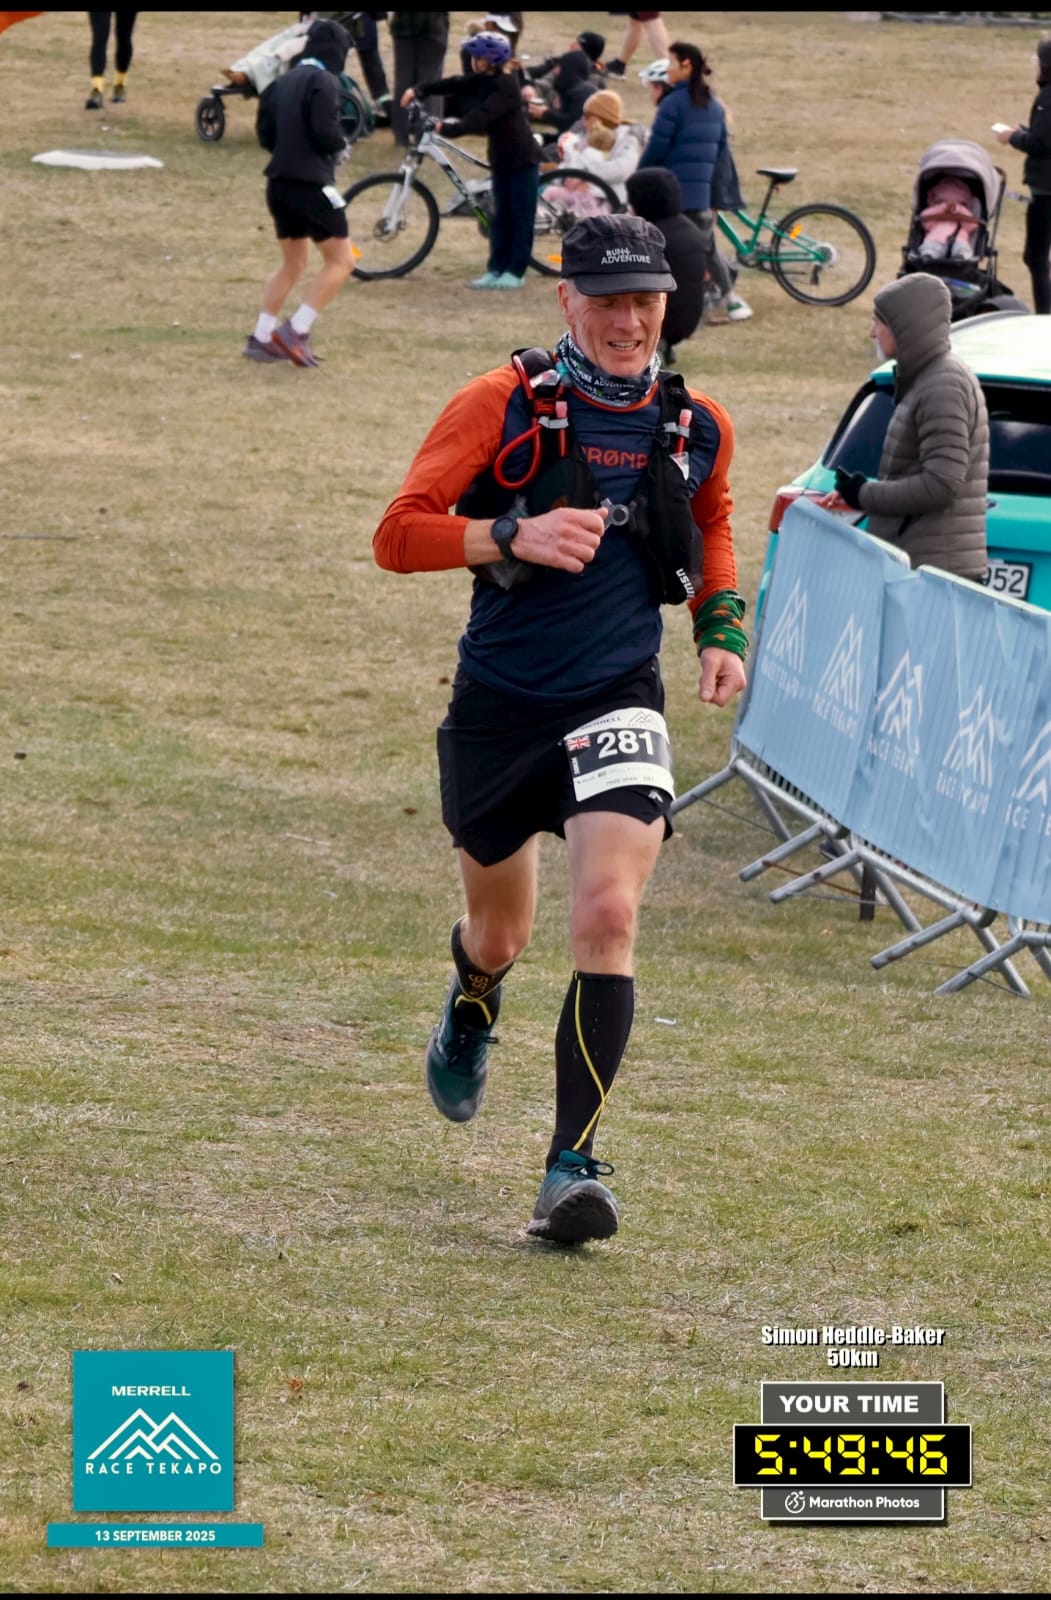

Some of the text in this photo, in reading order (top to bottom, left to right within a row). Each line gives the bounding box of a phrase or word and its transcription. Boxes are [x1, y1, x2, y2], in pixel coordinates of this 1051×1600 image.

[601, 254, 651, 265] ADVENTURE
[812, 692, 831, 721] RACE
[596, 729, 655, 760] 281
[936, 771, 957, 799] RACE
